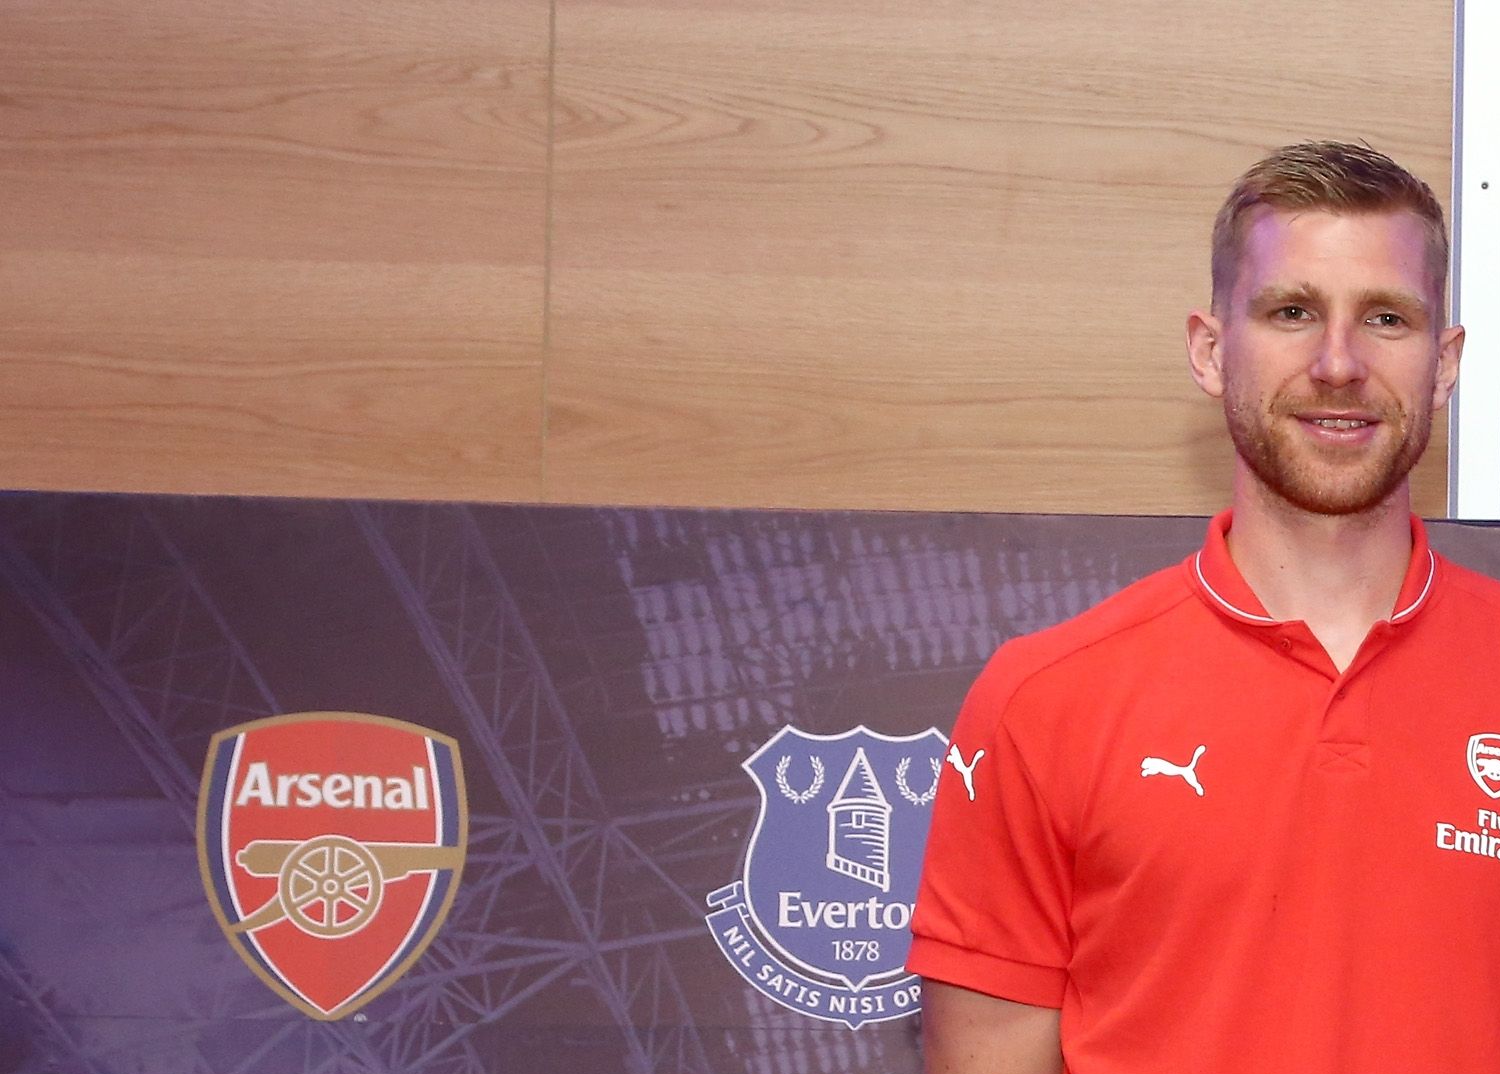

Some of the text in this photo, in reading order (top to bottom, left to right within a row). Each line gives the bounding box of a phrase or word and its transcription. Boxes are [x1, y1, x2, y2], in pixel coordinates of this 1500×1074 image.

[236, 762, 428, 810] Arsenal
[779, 892, 915, 929] Everto
[724, 926, 754, 967] NIL
[757, 964, 820, 1007] SATIS
[829, 995, 884, 1013] NISI
[832, 940, 879, 961] 1878
